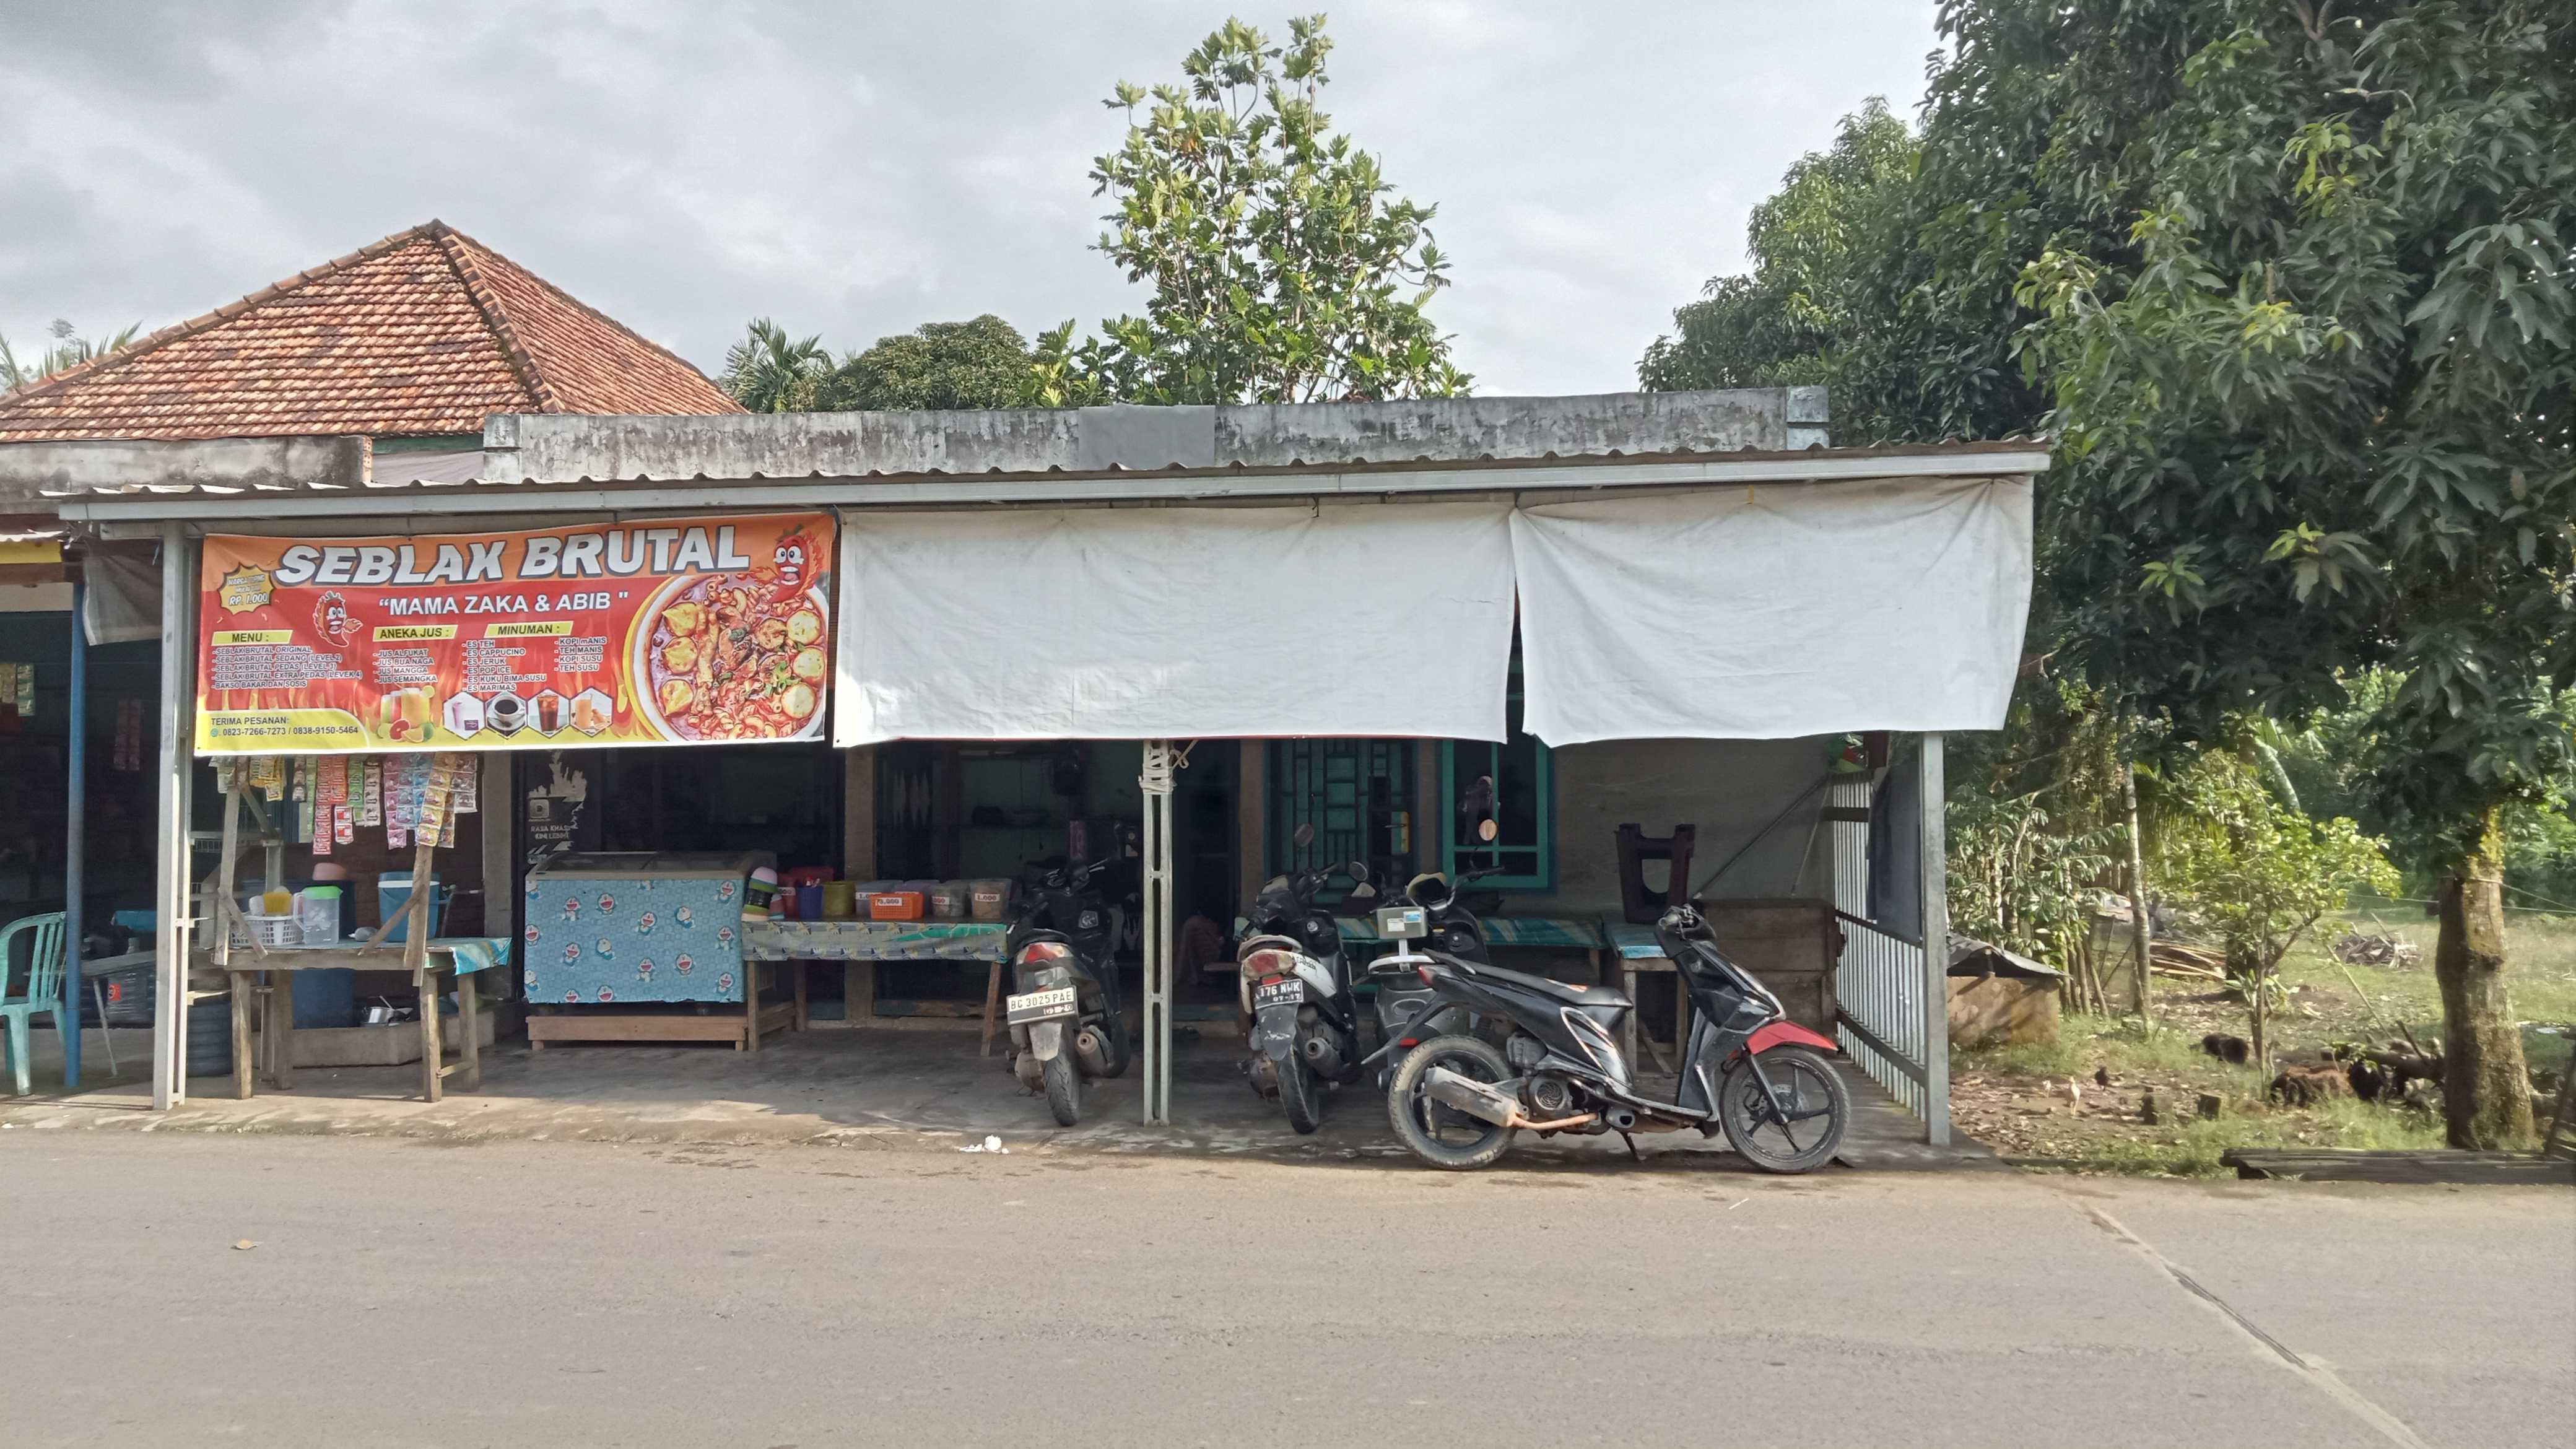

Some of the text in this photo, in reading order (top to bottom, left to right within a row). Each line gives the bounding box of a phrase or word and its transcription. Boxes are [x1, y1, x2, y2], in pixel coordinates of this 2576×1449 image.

[275, 526, 750, 585] SEBLAK BRUTAL
[464, 594, 528, 614] ZAKA
[535, 594, 551, 611] &
[380, 629, 417, 638] ANEKA
[420, 627, 442, 638] JUS
[498, 624, 553, 635] MINUMAN
[293, 726, 358, 735] 0838-9150-5464
[1281, 981, 1300, 994] NWK
[1026, 994, 1050, 1007] 3025
[1053, 991, 1071, 1003] PAE
